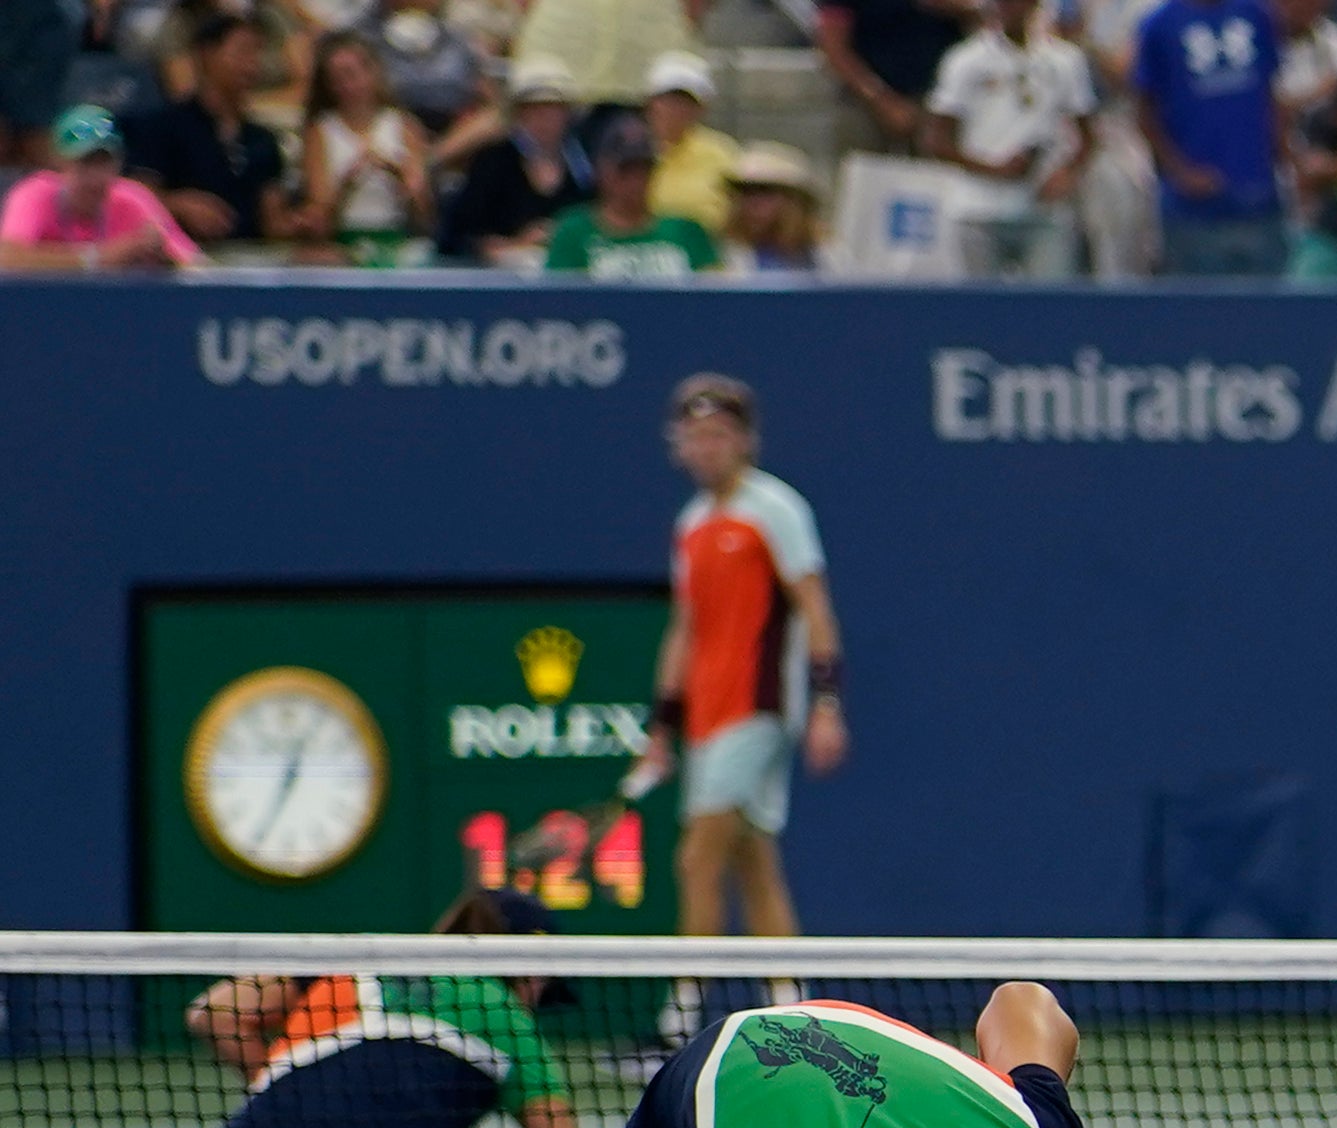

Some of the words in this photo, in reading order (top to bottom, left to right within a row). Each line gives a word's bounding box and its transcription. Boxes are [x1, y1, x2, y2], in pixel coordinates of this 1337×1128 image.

[201, 318, 625, 387] USOPEN.ORG
[931, 347, 1299, 441] Emirates
[451, 703, 649, 758] ROLEX
